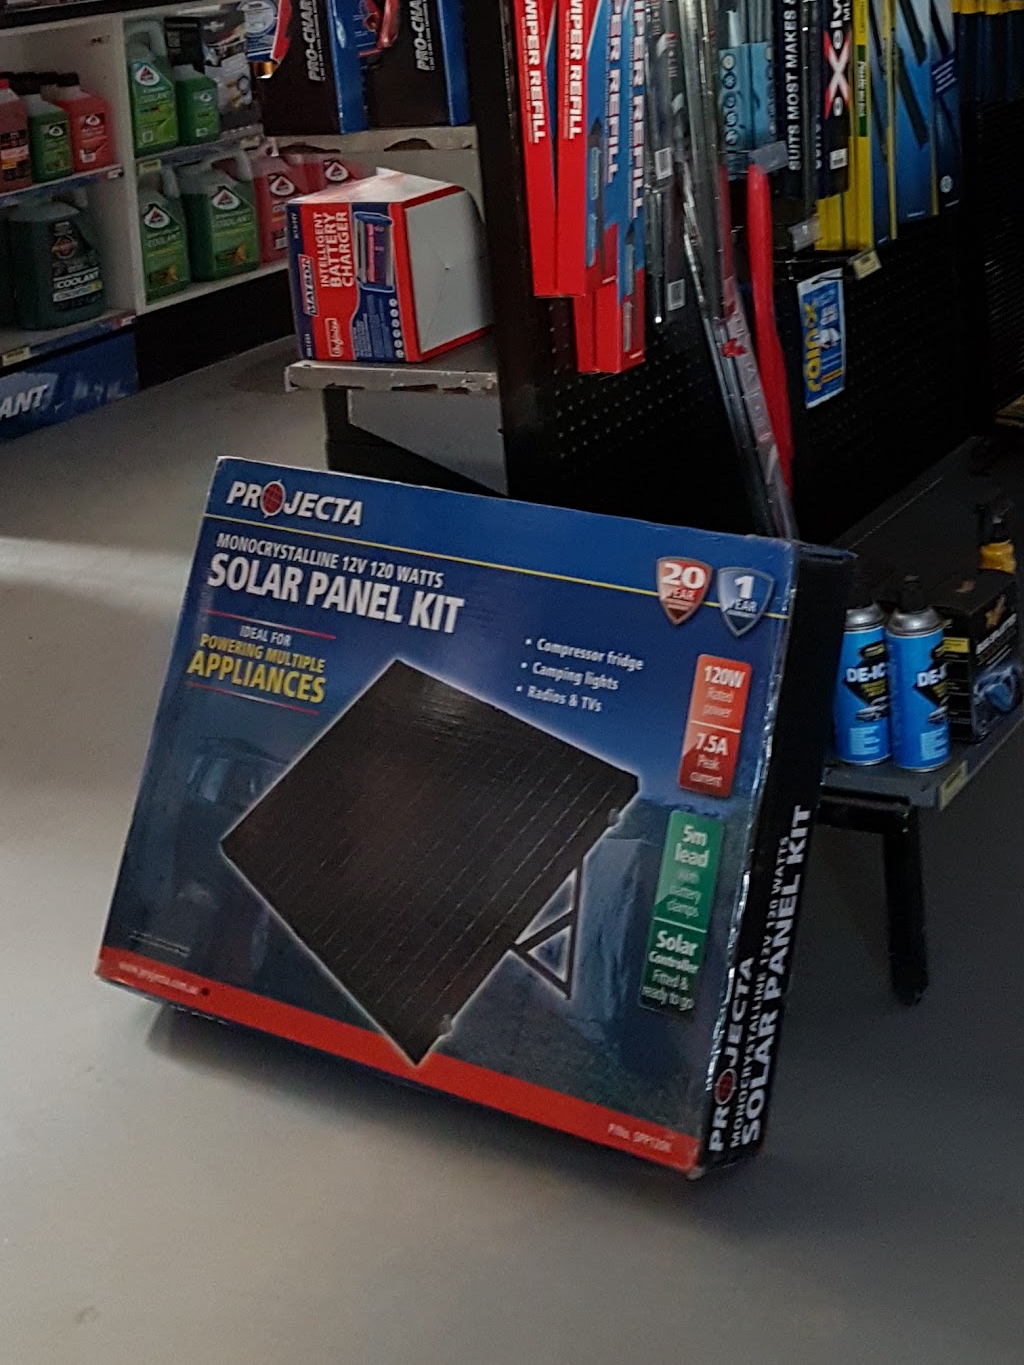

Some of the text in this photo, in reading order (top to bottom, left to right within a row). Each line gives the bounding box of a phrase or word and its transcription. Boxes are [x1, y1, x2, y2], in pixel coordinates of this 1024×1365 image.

[783, 10, 798, 69] MAKES
[529, 70, 546, 143] REFILL
[568, 64, 583, 140] REFILL
[787, 71, 800, 119] MOST
[607, 68, 621, 184] REFILL
[788, 121, 801, 171] SUITS
[630, 95, 645, 219] REFILL
[313, 212, 330, 288] INTELLIGENT
[323, 212, 343, 288] BATTERY
[335, 211, 354, 287] CHARGER
[226, 480, 363, 526] PROJECTA
[217, 532, 444, 589] MONOCRYSTALLINE 12V 120 WATTS
[662, 562, 706, 590] 20
[734, 575, 755, 600] 1
[207, 552, 465, 633] SOLAR PANEL KIT
[200, 633, 326, 673] POWERING MULTIPLE
[239, 624, 292, 647] IDEAL FOR
[536, 638, 644, 671] Compressor fridge
[187, 650, 326, 704] APPLIANCES
[527, 685, 603, 712] Radios & TVs
[531, 662, 619, 691] Camping lights
[704, 665, 745, 689] 120W
[675, 843, 710, 868] lead
[656, 930, 699, 956] Solar
[730, 971, 766, 1149] MONOCRYSTALLINE
[770, 836, 790, 897] WATTS
[740, 805, 812, 1145] SOLAR PANEL KIT
[709, 957, 755, 1152] PROJECTA
